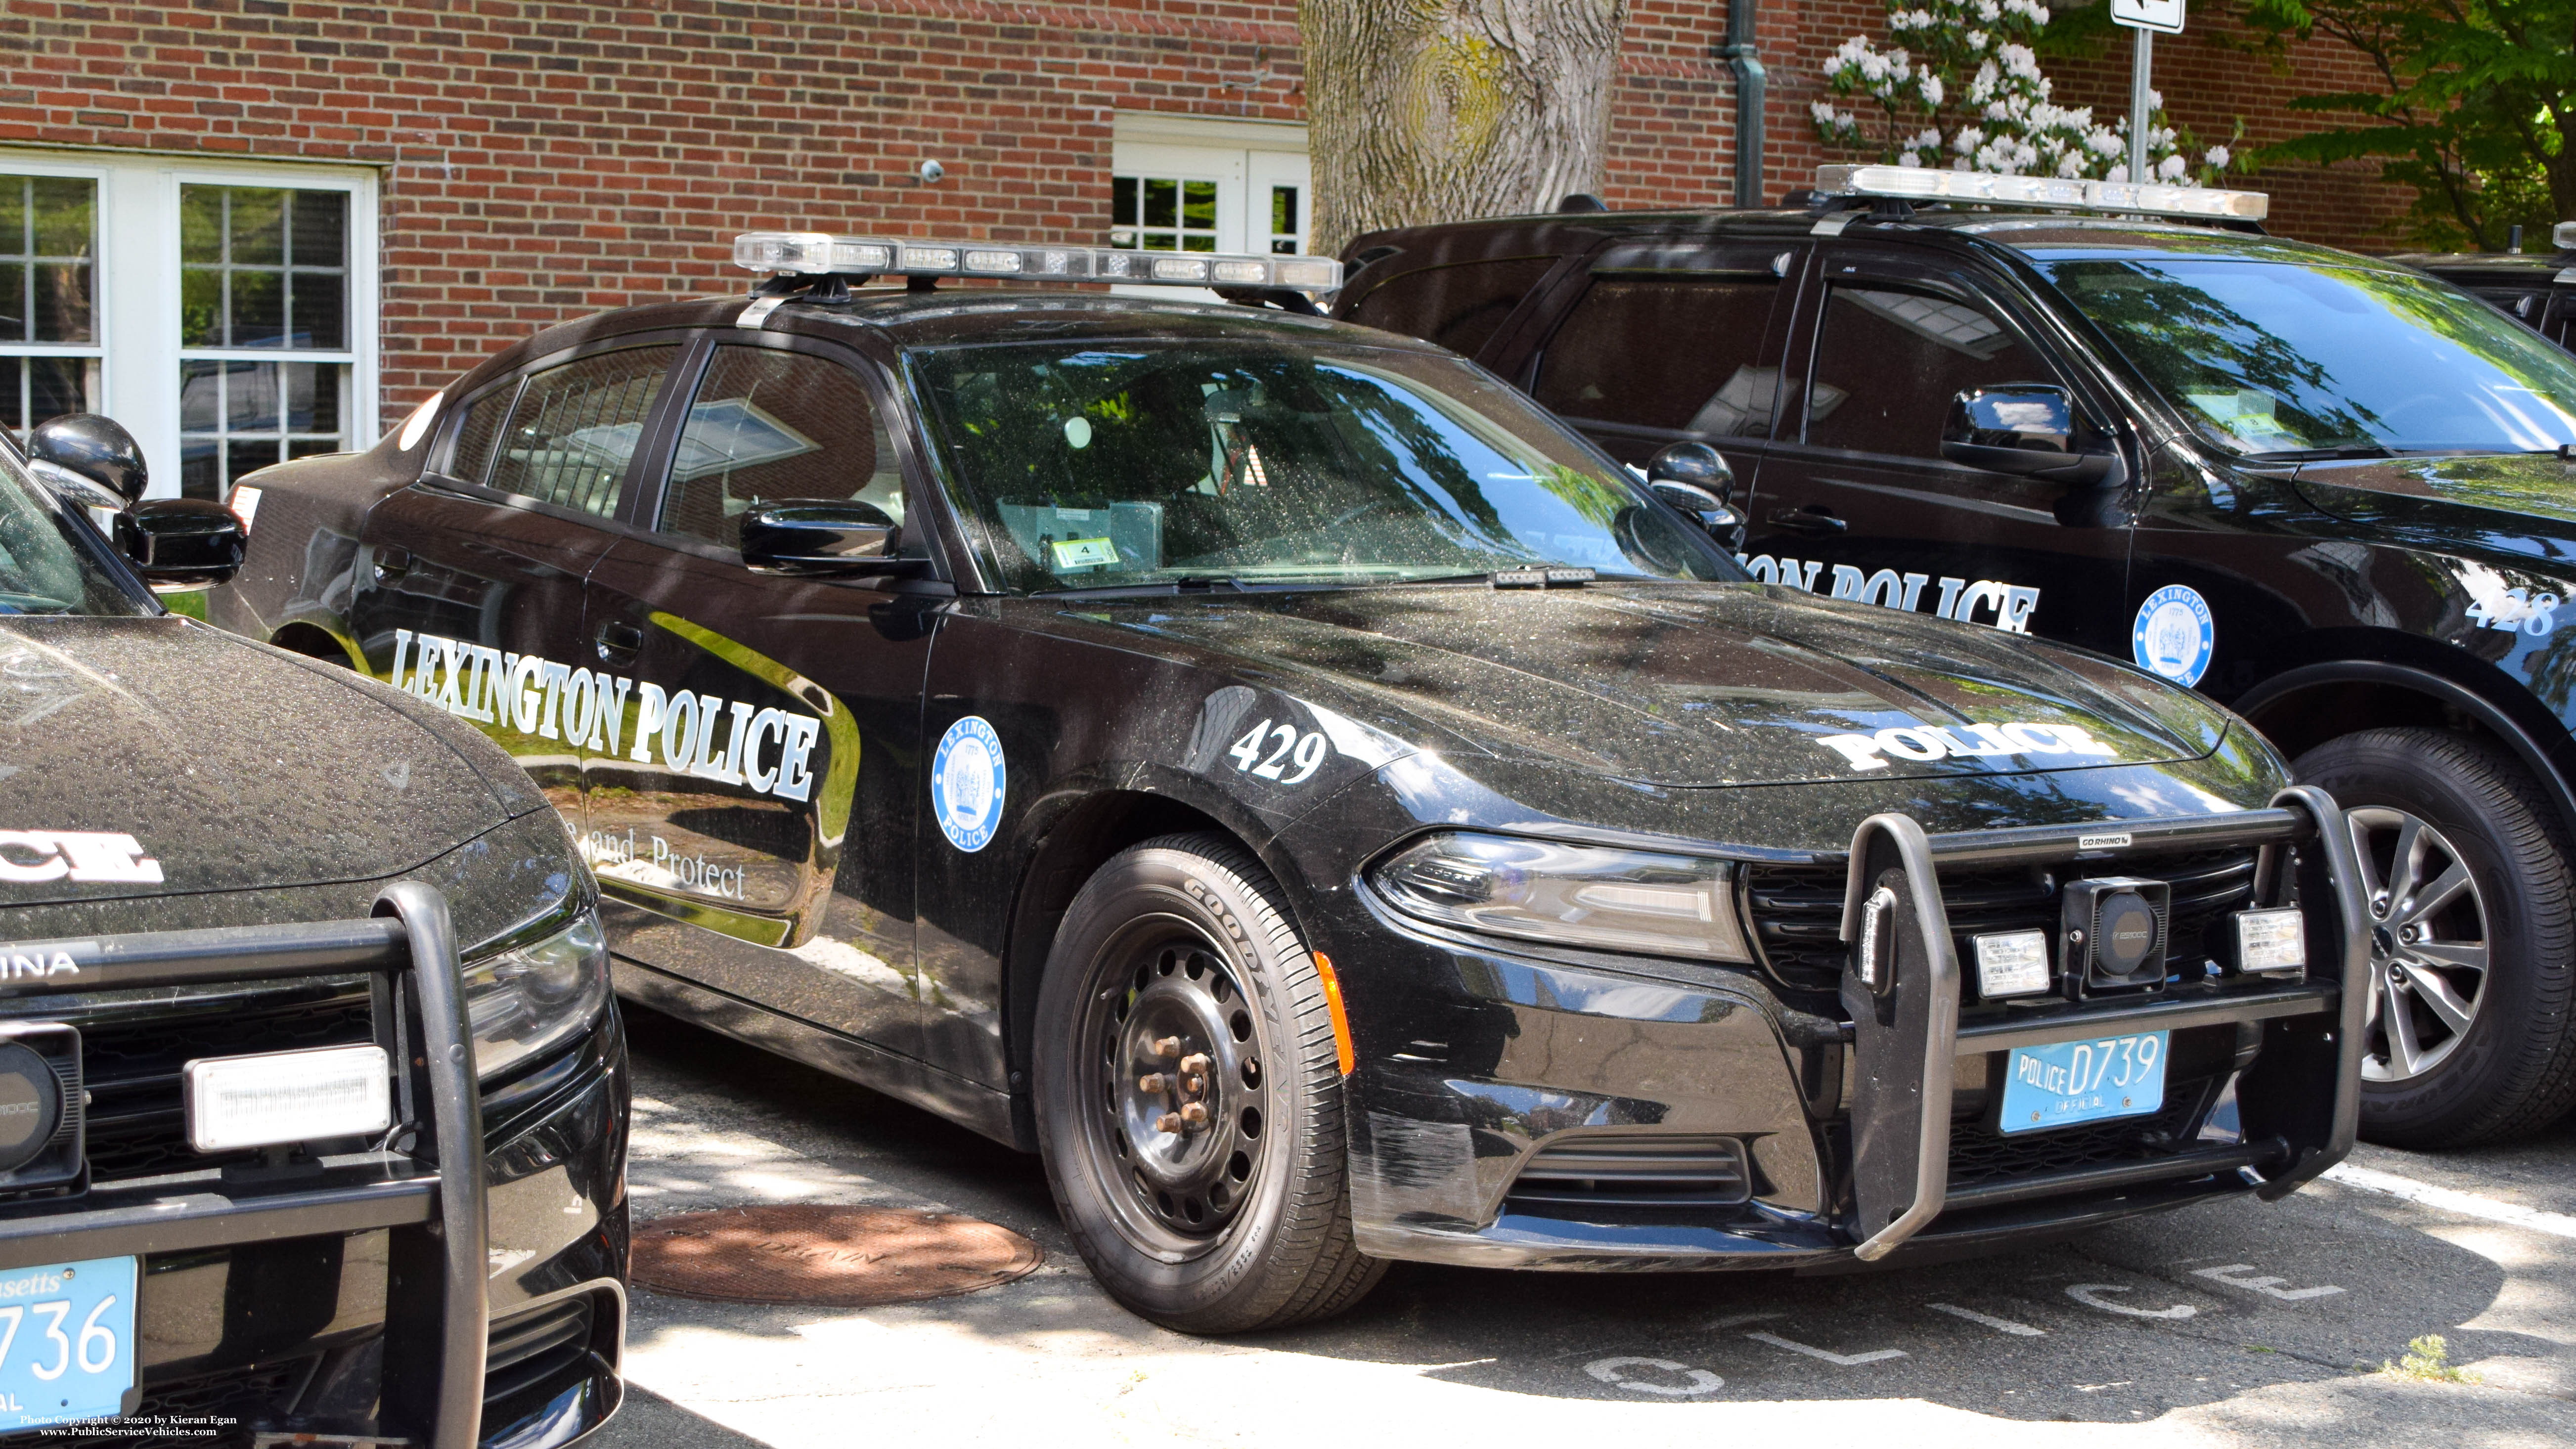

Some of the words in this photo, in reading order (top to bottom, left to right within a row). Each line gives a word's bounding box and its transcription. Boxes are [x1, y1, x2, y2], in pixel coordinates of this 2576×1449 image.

[2141, 588, 2209, 625] LEXINGTON
[2169, 607, 2184, 617] 1775
[2465, 585, 2560, 636] 428
[391, 628, 632, 756] LEXINGTON
[629, 681, 821, 803] POLICE
[940, 720, 1002, 767] LEXINGTON
[965, 744, 979, 756] 1775
[1230, 719, 1327, 785] 429
[1815, 722, 2118, 771] POLICE
[942, 814, 988, 847] POLICE
[592, 828, 634, 864] and
[651, 835, 746, 901] Protect
[2018, 1054, 2067, 1096] POLICE
[2068, 1035, 2159, 1096] D739
[2055, 1095, 2106, 1114] OFFICIAL
